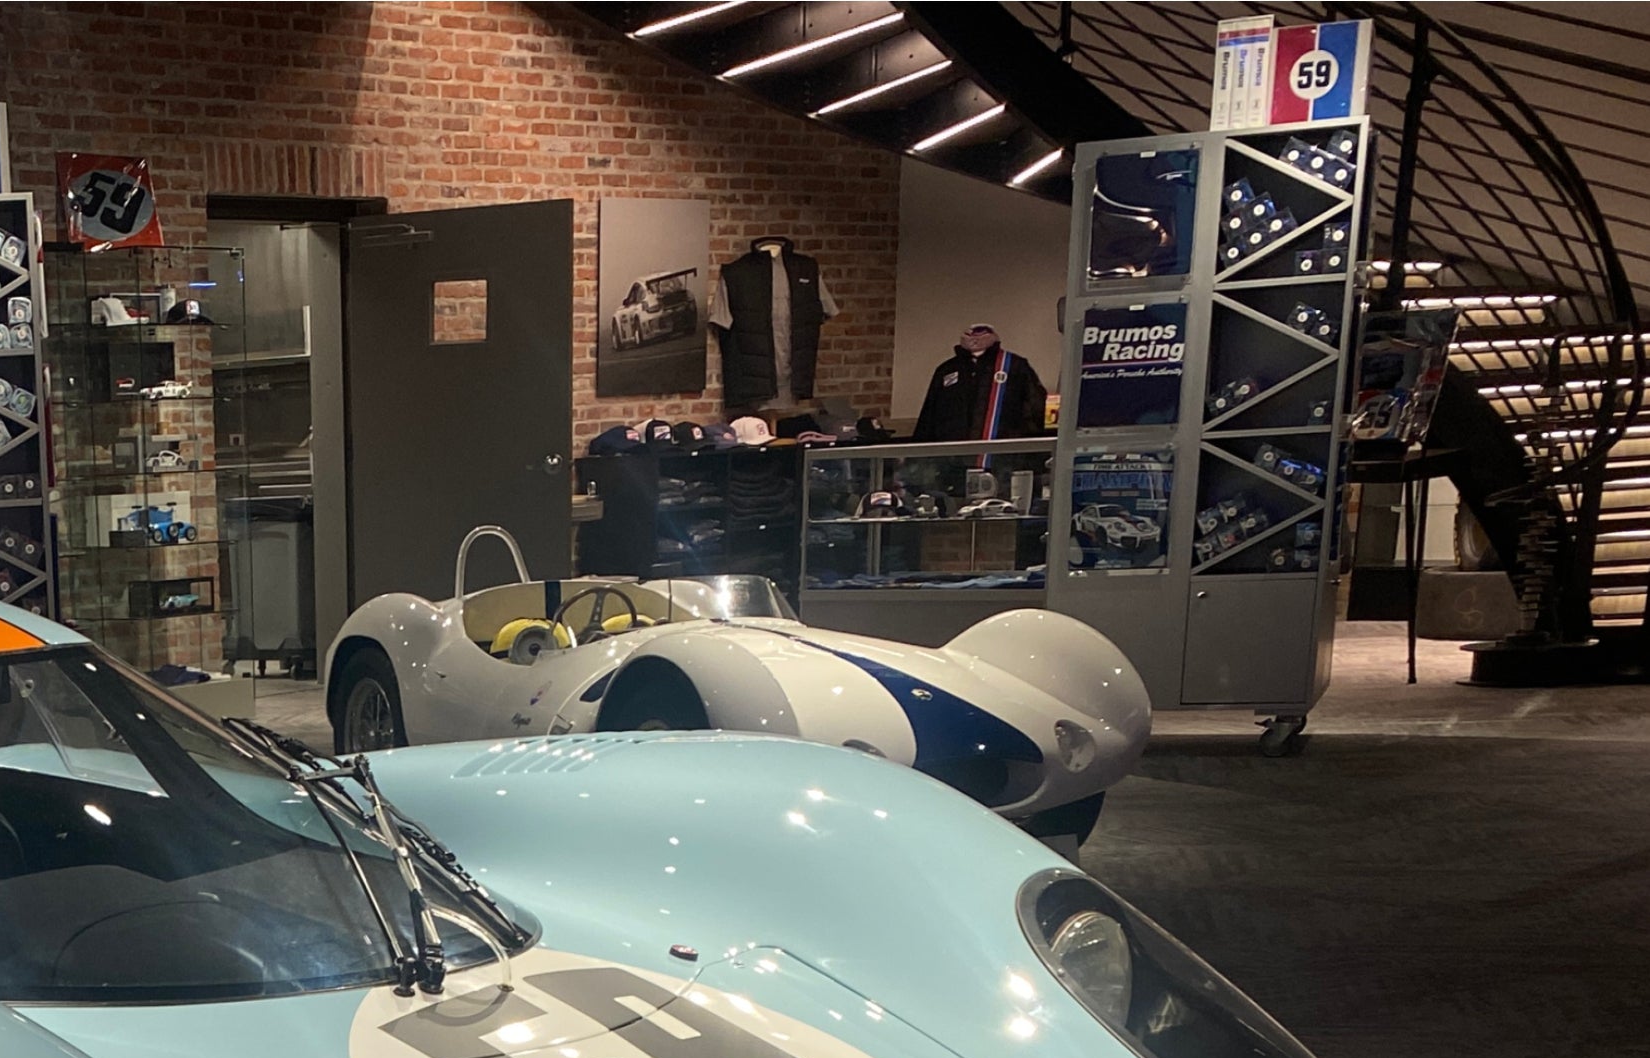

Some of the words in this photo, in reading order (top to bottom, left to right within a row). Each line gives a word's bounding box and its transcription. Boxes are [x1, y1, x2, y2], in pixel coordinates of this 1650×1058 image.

[1298, 59, 1332, 89] 59
[76, 171, 146, 235] 59
[1083, 324, 1178, 345] Brumos
[1102, 341, 1185, 362] Racing
